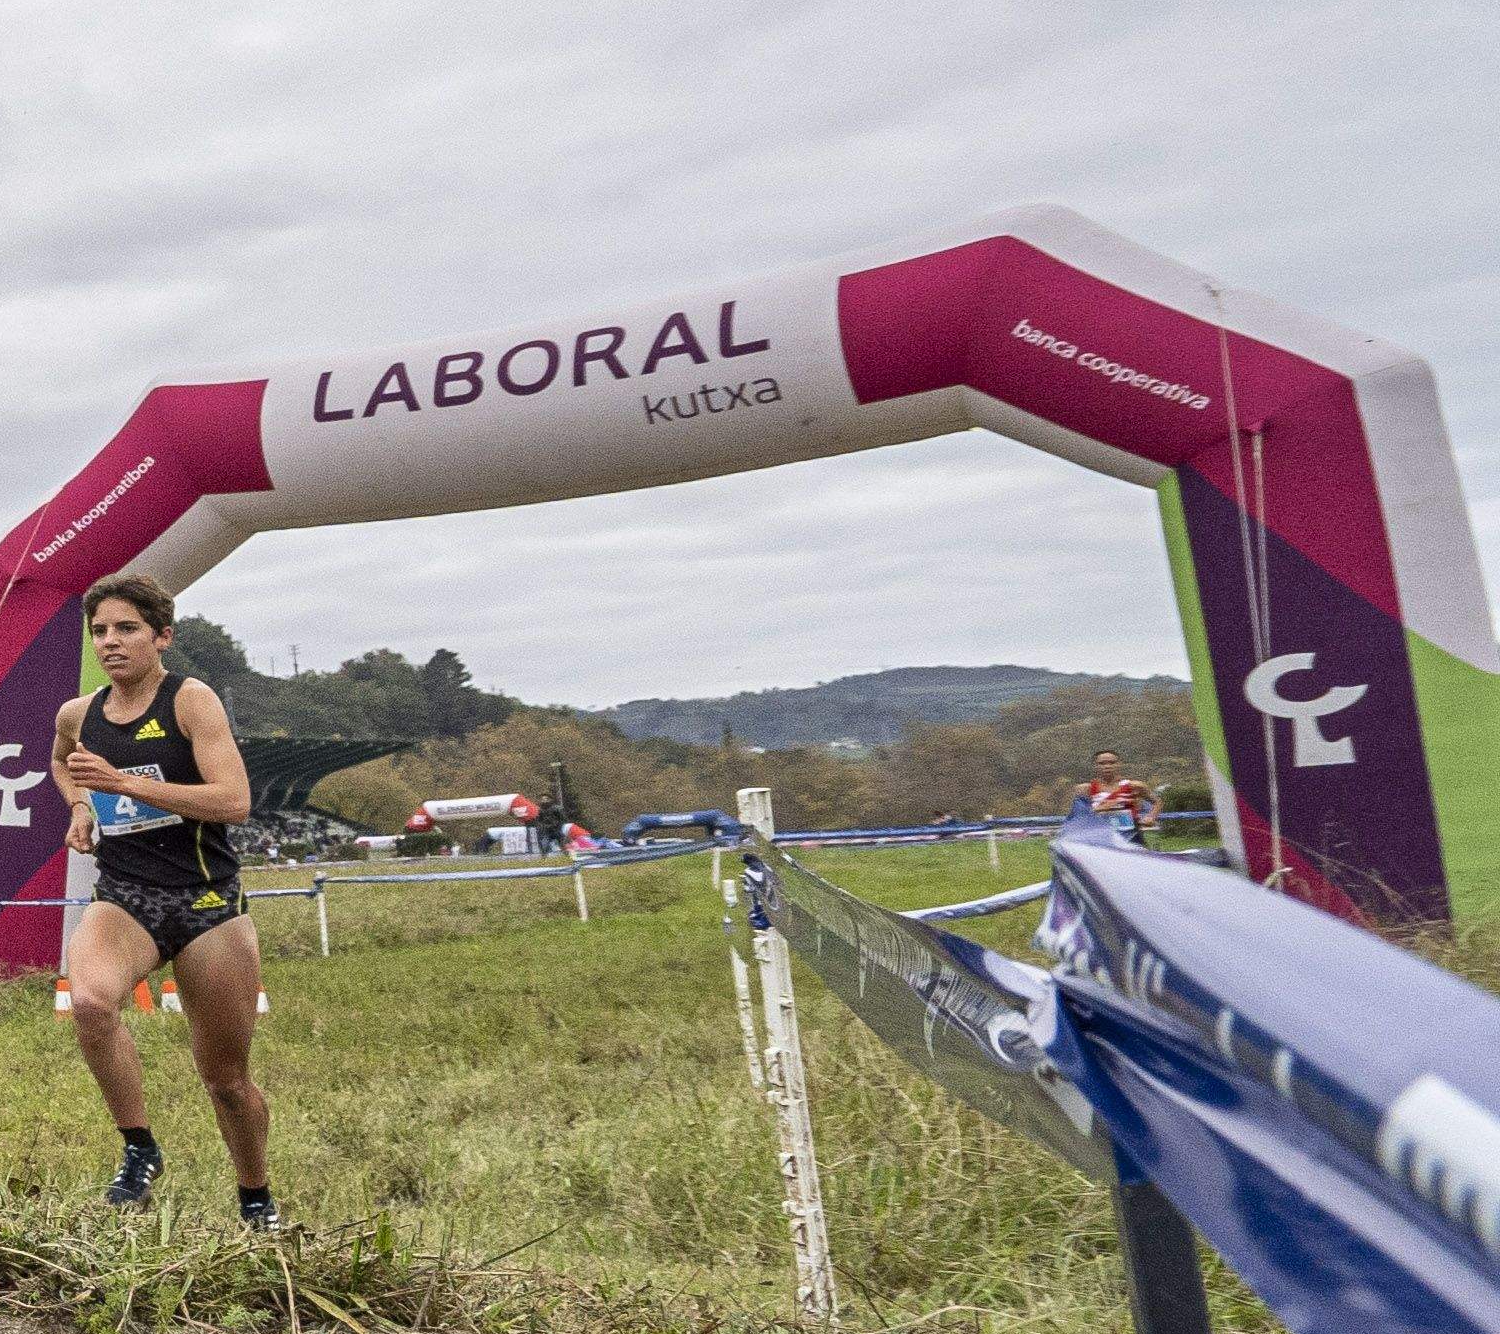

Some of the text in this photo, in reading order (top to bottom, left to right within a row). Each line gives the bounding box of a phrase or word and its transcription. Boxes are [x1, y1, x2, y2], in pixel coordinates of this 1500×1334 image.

[313, 301, 771, 422] LABORAL
[643, 376, 783, 425] kutxa
[1010, 319, 1212, 410] banca cooperativa
[32, 455, 156, 563] banka kooperatiboa
[115, 794, 138, 817] 4
